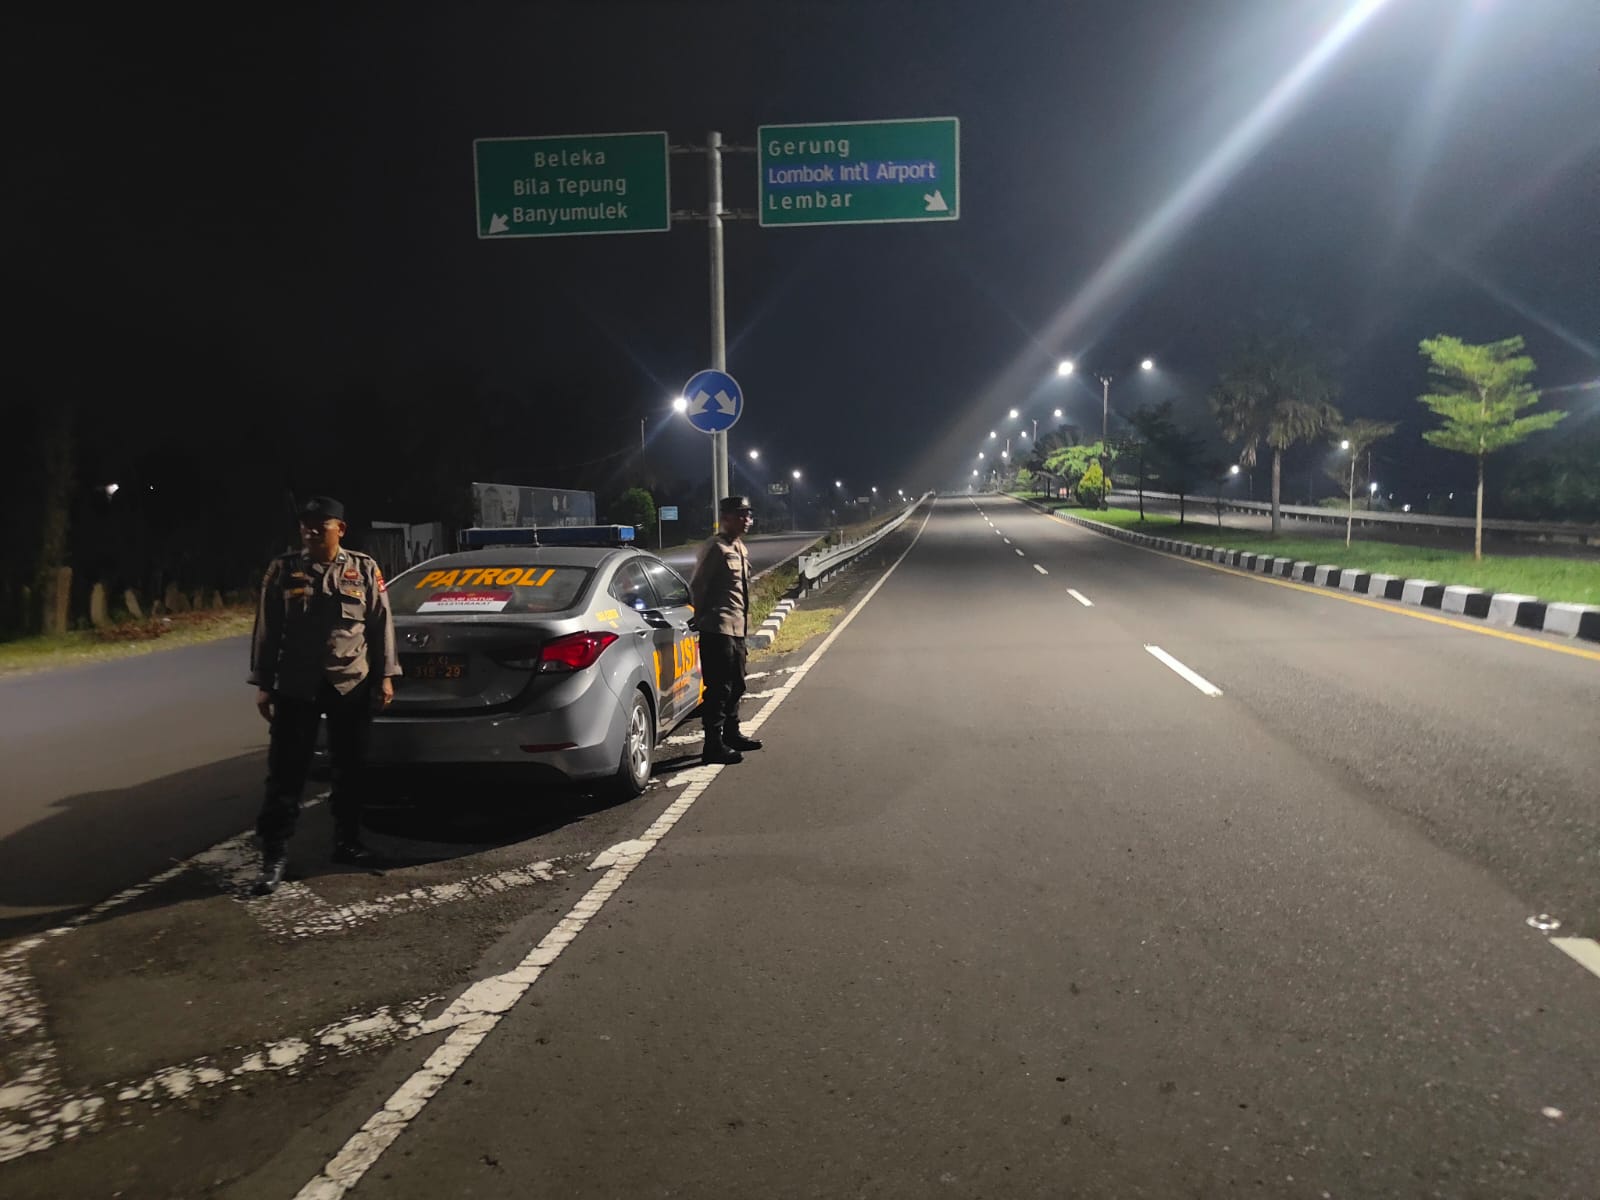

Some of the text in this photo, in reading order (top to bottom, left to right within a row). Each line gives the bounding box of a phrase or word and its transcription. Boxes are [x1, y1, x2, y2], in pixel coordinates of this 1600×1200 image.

[768, 138, 850, 157] Gerung
[534, 150, 605, 168] Beleka
[768, 164, 834, 184] Lombok
[876, 160, 936, 182] Airport
[513, 177, 627, 197] Bila Tepung
[769, 190, 853, 210] Lembar
[512, 202, 628, 225] Banyumulek
[415, 568, 556, 589] PATROLI
